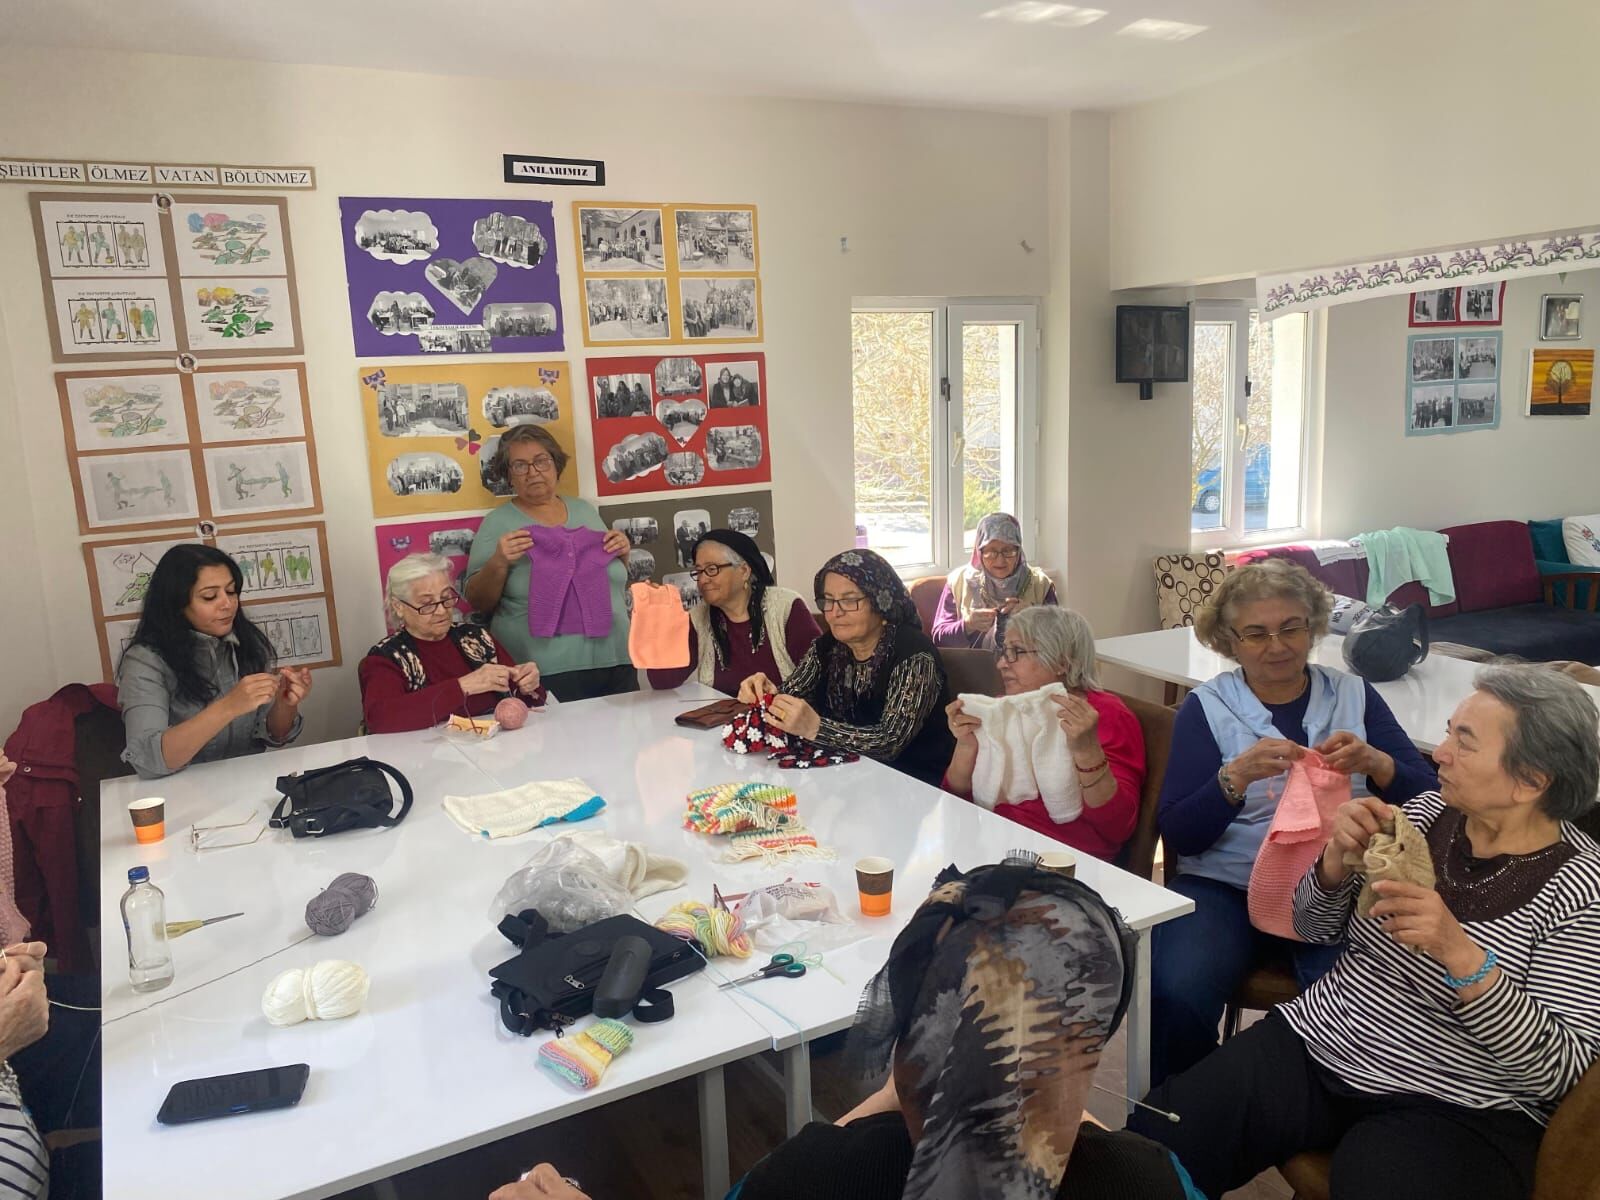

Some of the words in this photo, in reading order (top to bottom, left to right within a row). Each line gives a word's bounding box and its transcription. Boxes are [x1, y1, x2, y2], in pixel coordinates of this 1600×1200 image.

[0, 163, 80, 179] ŞEHİTLER
[91, 165, 149, 181] ÖLMEZ
[159, 169, 214, 182] VATAN
[224, 170, 308, 184] BÖLÜNMEZ
[522, 165, 588, 176] ANILARIMIZ
